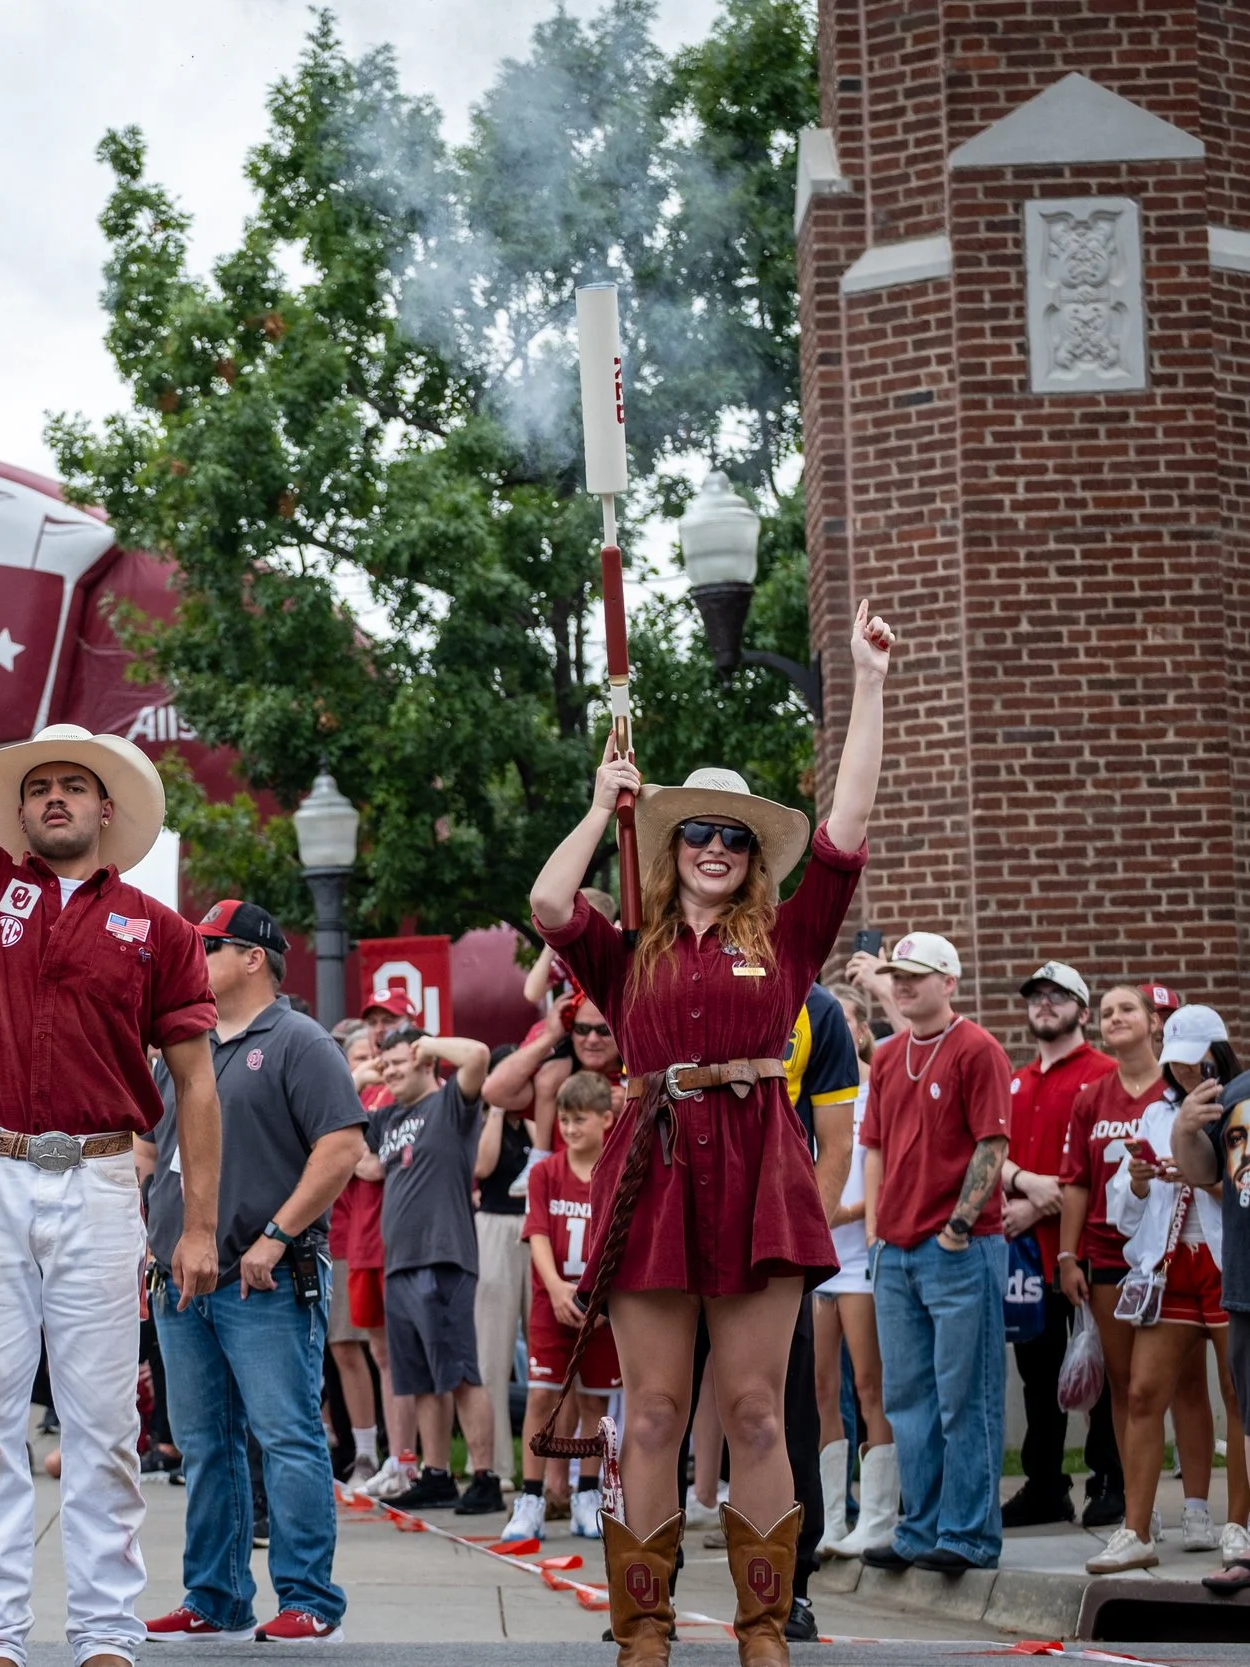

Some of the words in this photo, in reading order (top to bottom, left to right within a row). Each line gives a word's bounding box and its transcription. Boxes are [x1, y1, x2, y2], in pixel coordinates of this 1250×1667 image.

[11, 886, 32, 910] OU
[0, 919, 20, 945] EC
[624, 1562, 661, 1610] OU
[746, 1556, 781, 1605] OU
